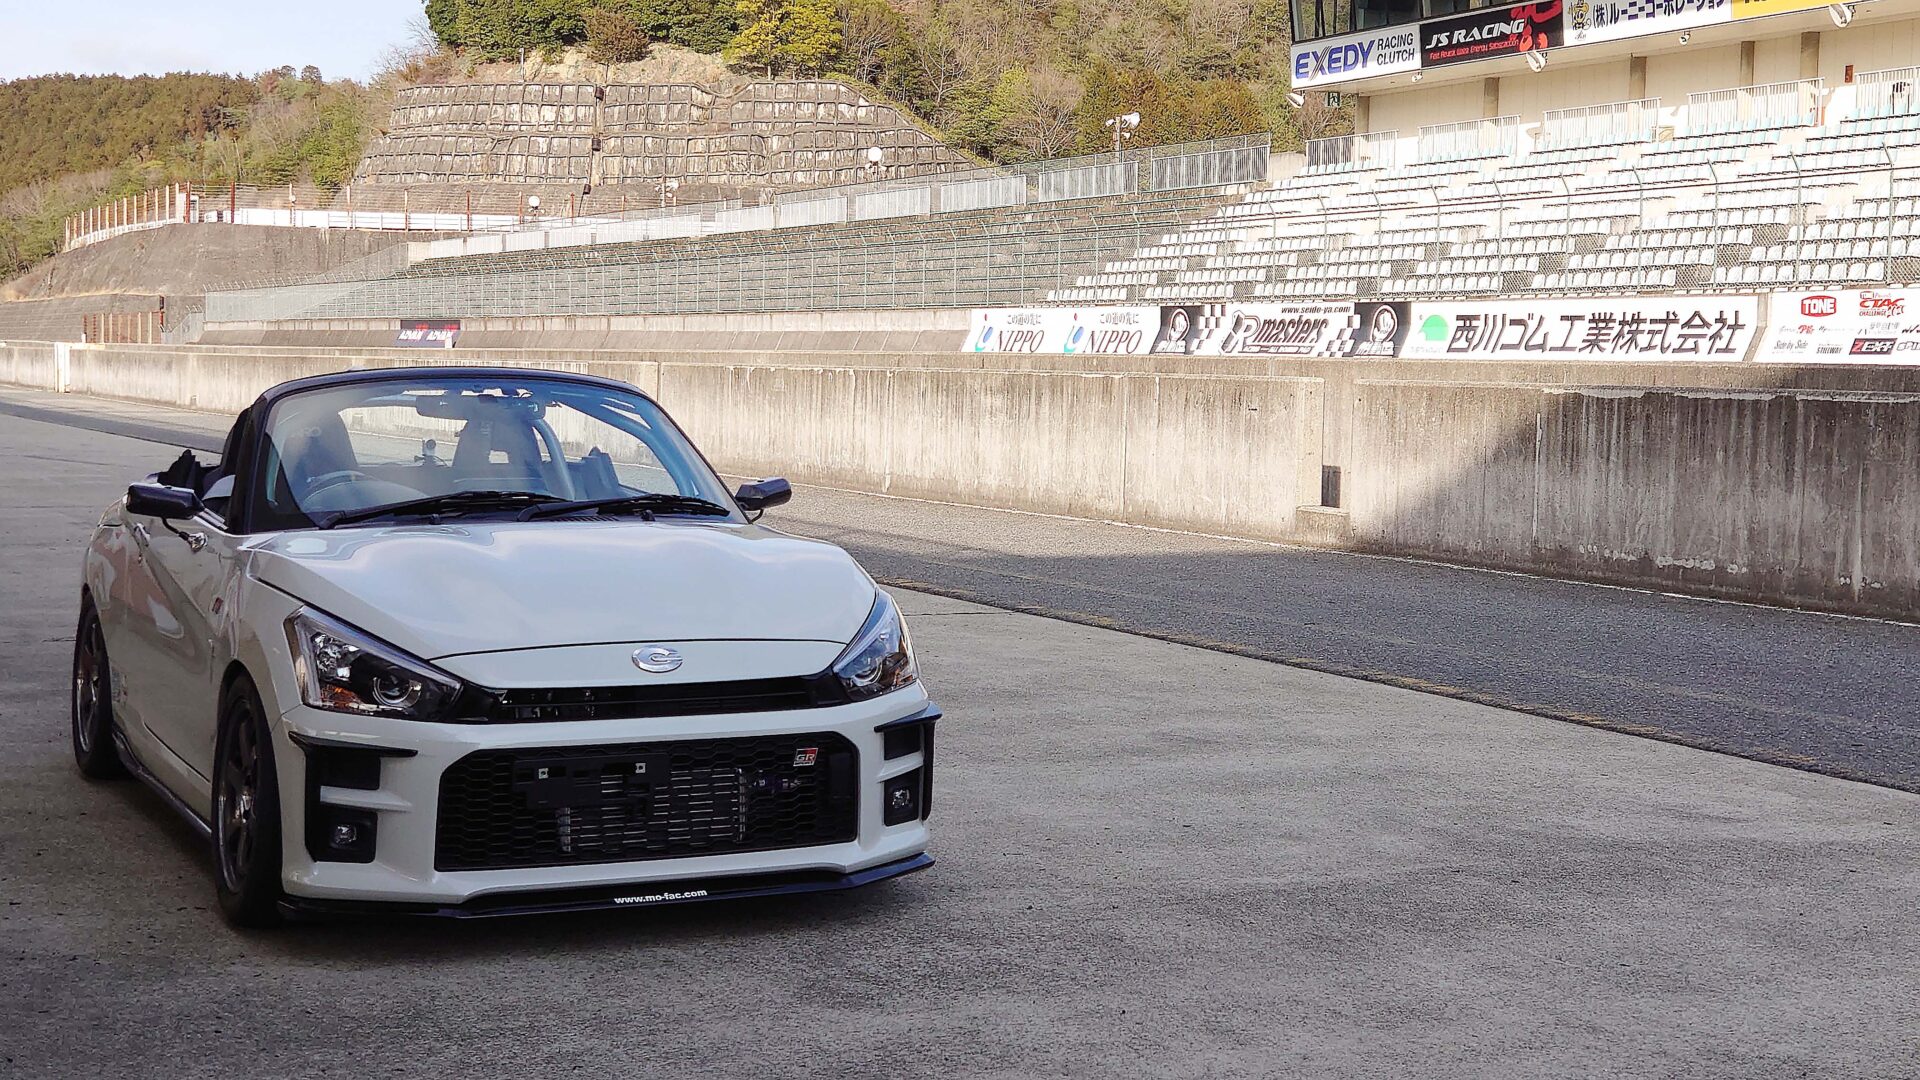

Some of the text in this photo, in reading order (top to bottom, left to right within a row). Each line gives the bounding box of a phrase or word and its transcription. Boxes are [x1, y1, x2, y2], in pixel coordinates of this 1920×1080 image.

[1377, 32, 1414, 51] RACING
[1425, 19, 1524, 49] J'S RACING
[1296, 40, 1375, 80] EXEDY
[1377, 48, 1415, 66] CLUTCH
[1803, 299, 1834, 314] TONE
[1007, 314, 1042, 325] この道の先に
[1100, 313, 1140, 325] この道の先に
[992, 330, 1046, 353] NIPPO
[1083, 330, 1143, 354] NIPPO
[1447, 310, 1746, 355] 西川ゴム工業株式会社
[614, 889, 708, 904] www.mo-fac.com
